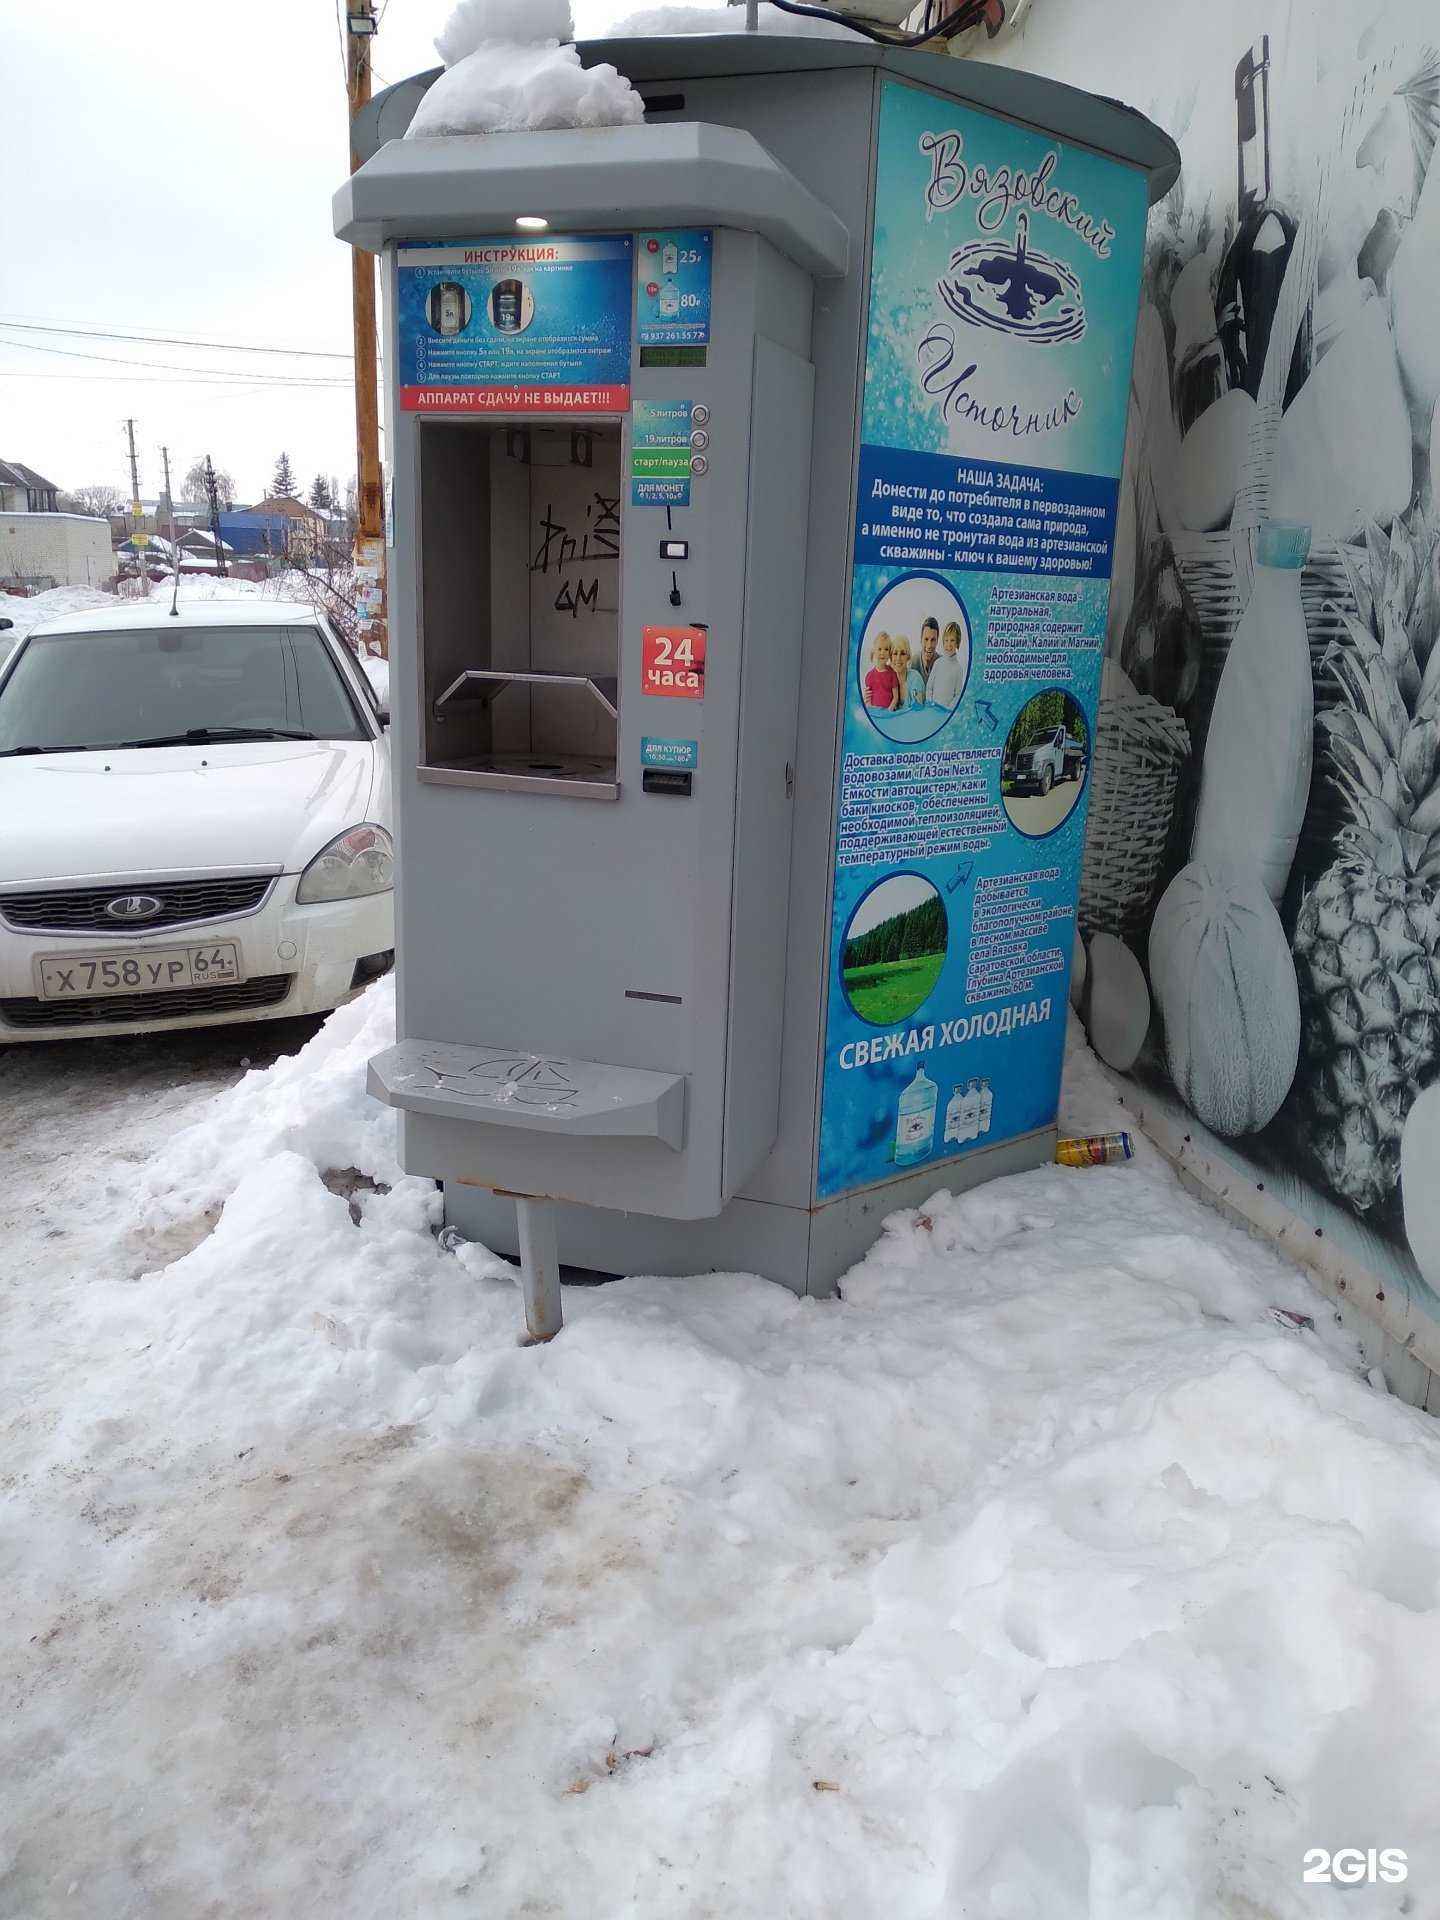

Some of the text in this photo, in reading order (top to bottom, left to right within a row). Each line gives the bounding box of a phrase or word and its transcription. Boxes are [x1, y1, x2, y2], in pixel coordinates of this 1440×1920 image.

[922, 134, 1115, 255] Вязовский
[464, 247, 559, 263] ИНСТРУКЦИЯ:
[918, 323, 1081, 435] Источник
[418, 391, 610, 406] АППАРАТ СДАЧУ НЕ ВЫДАЕТ!!!
[645, 434, 655, 444] 19
[634, 456, 689, 468] старт/пауза
[655, 483, 684, 493] МОНЕТ
[957, 468, 1045, 493] НАША ЗАДАЧА:
[872, 478, 1106, 519] Донести до потребителя в первозданном
[892, 505, 1090, 537] виде то, что создала сама природа,
[861, 523, 1108, 556] а именно не тронутая вода из артезианской
[880, 543, 1093, 572] скважины ключ к вашему здоровью!
[991, 587, 1055, 602] Артезианская
[990, 606, 1052, 619] натуральная,
[988, 621, 1084, 634] природная содержит
[654, 636, 694, 667] 24
[1032, 636, 1059, 648] Калий
[985, 652, 1067, 665] необходимые для
[648, 669, 699, 688] часа
[984, 669, 1029, 681] здоровья
[664, 745, 692, 754] КУПЮР
[844, 748, 1001, 770] Доставка воды осуществляется
[843, 769, 912, 786] водовозами
[914, 767, 950, 780] «ГАЗон
[842, 787, 890, 801] Емкости
[891, 782, 960, 798] автоцистерн,
[961, 781, 980, 791] как
[842, 804, 869, 817] баки
[871, 800, 918, 816] киосков,
[840, 805, 1001, 834] необходимой теплоизоляцией,
[839, 819, 1008, 850] поддерживающей естественный
[839, 840, 991, 866] температурный режим воды.
[976, 868, 1060, 889] Артезианская вода
[974, 888, 1029, 906] добывается
[981, 899, 1041, 917] экологически
[972, 906, 1073, 933] благополучном районе
[978, 931, 1011, 945] лесном
[1012, 925, 1048, 939] массиве
[194, 949, 225, 972] 64
[969, 943, 1028, 961] села Вязовка
[967, 960, 1064, 990] Глубина Артезианской
[968, 955, 1026, 975] Саратовской
[193, 971, 217, 982] RUS
[966, 986, 1011, 1004] скважины
[1013, 981, 1023, 993] 60
[839, 998, 1052, 1070] СВЕЖАЯ ХОЛОДНАЯ
